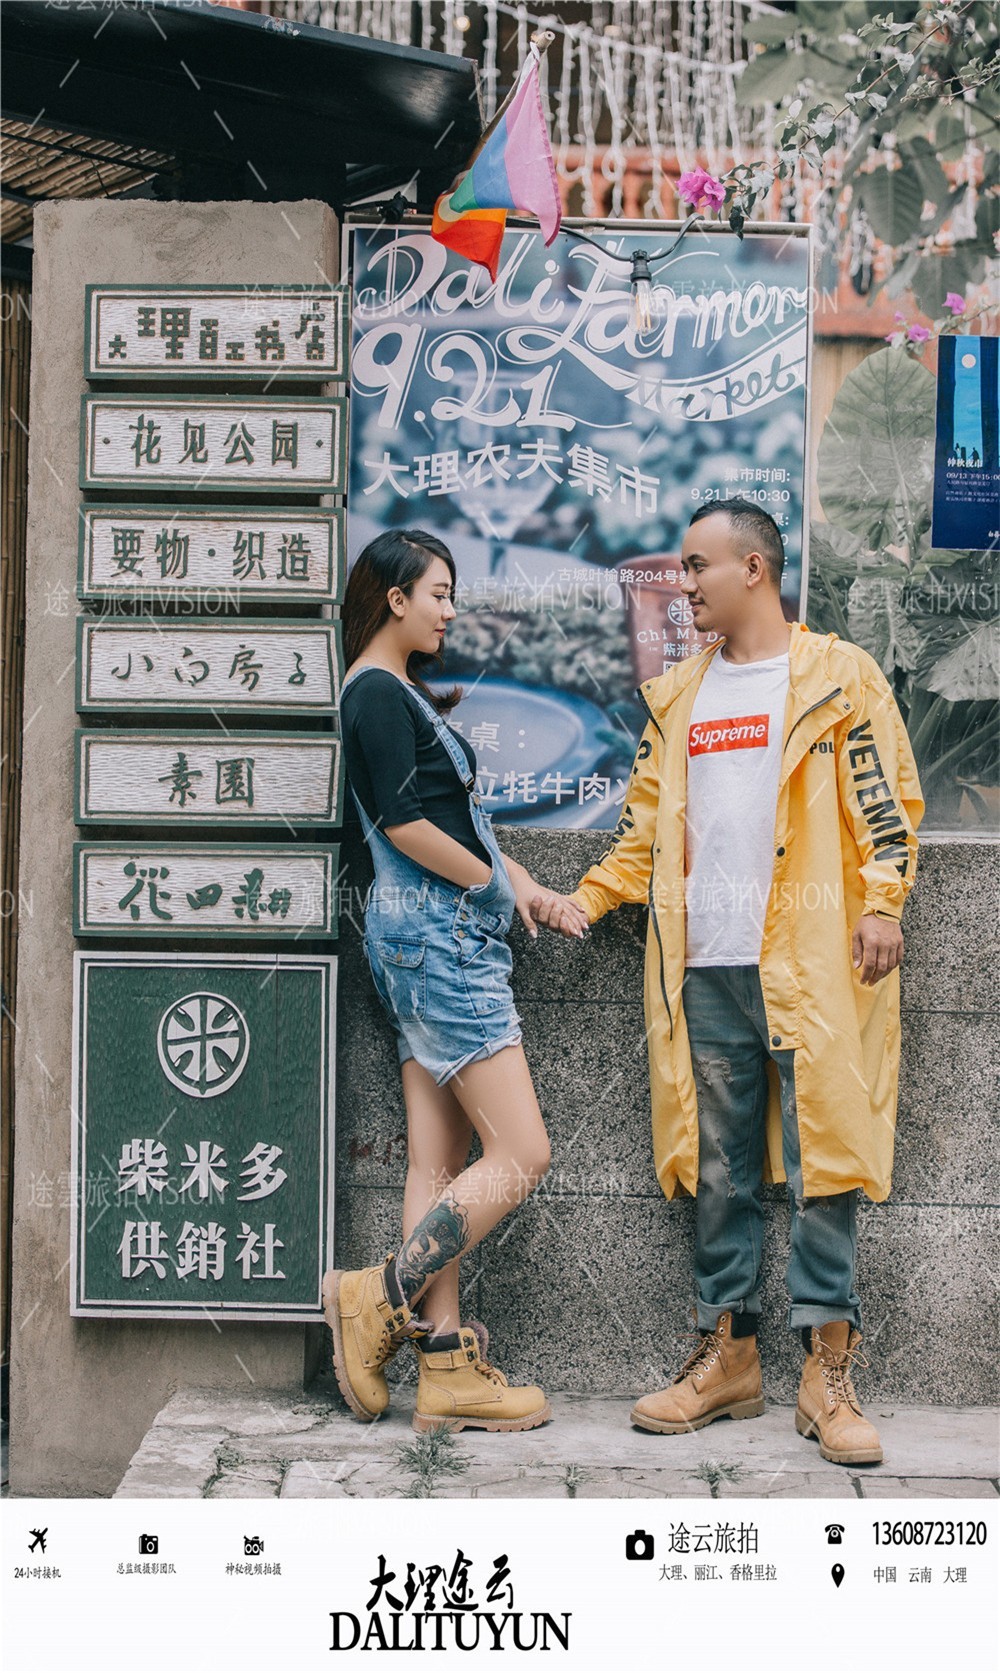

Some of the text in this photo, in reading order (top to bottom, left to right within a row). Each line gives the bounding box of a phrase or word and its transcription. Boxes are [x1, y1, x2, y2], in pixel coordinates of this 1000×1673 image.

[352, 232, 566, 324] Dali
[351, 322, 578, 432] 9.21
[363, 438, 661, 518] 大理农夫集市
[724, 467, 791, 483] 集市时间:
[636, 629, 668, 644] Chi
[706, 631, 726, 643] D
[111, 644, 308, 692] 小白房子
[690, 722, 766, 749] Supreme
[118, 1138, 289, 1201] 柴米多
[116, 1220, 287, 1280] 供銷社
